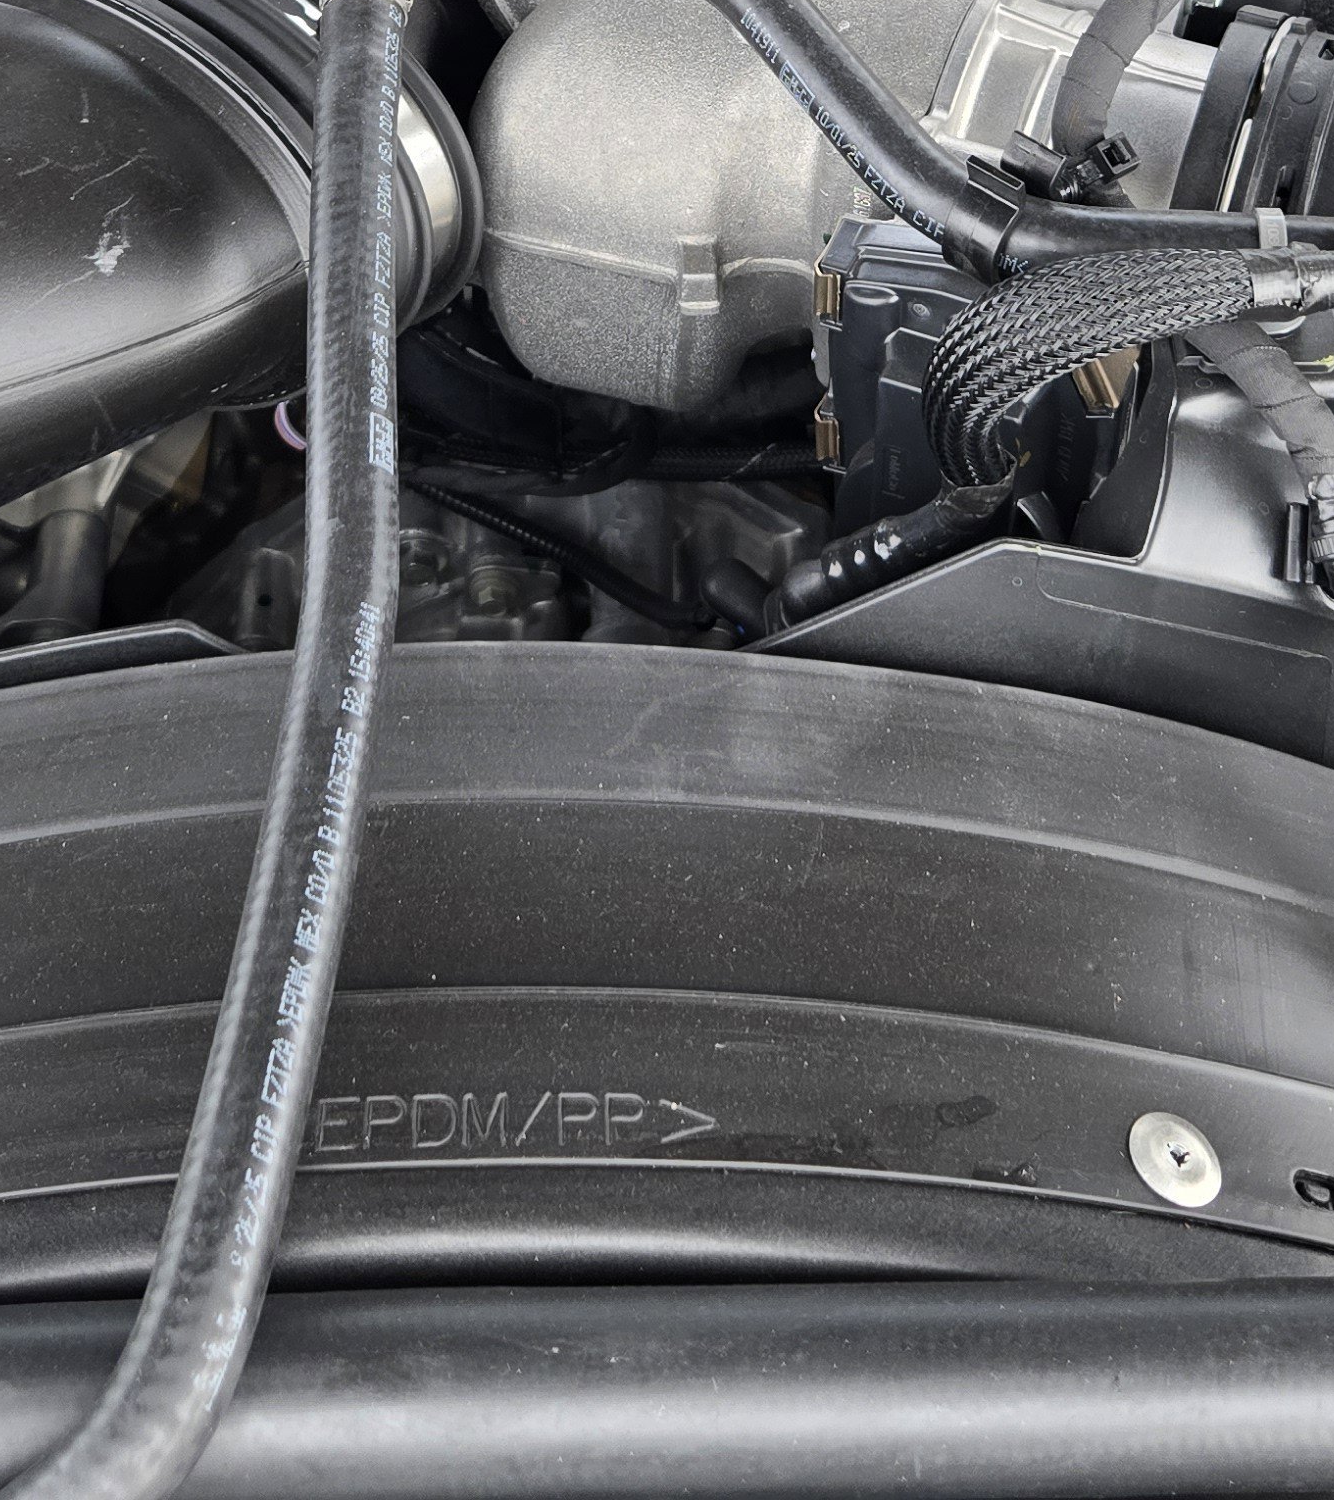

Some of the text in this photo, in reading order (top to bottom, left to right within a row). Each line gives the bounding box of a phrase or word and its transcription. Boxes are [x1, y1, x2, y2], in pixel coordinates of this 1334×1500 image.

[381, 86, 397, 102] B
[379, 137, 395, 167] MEX
[814, 105, 864, 169] 10/01/25
[373, 291, 391, 328] CIP
[249, 1115, 276, 1162] CIP
[294, 908, 327, 951] MEX
[318, 824, 343, 845] B
[341, 686, 369, 718] B2
